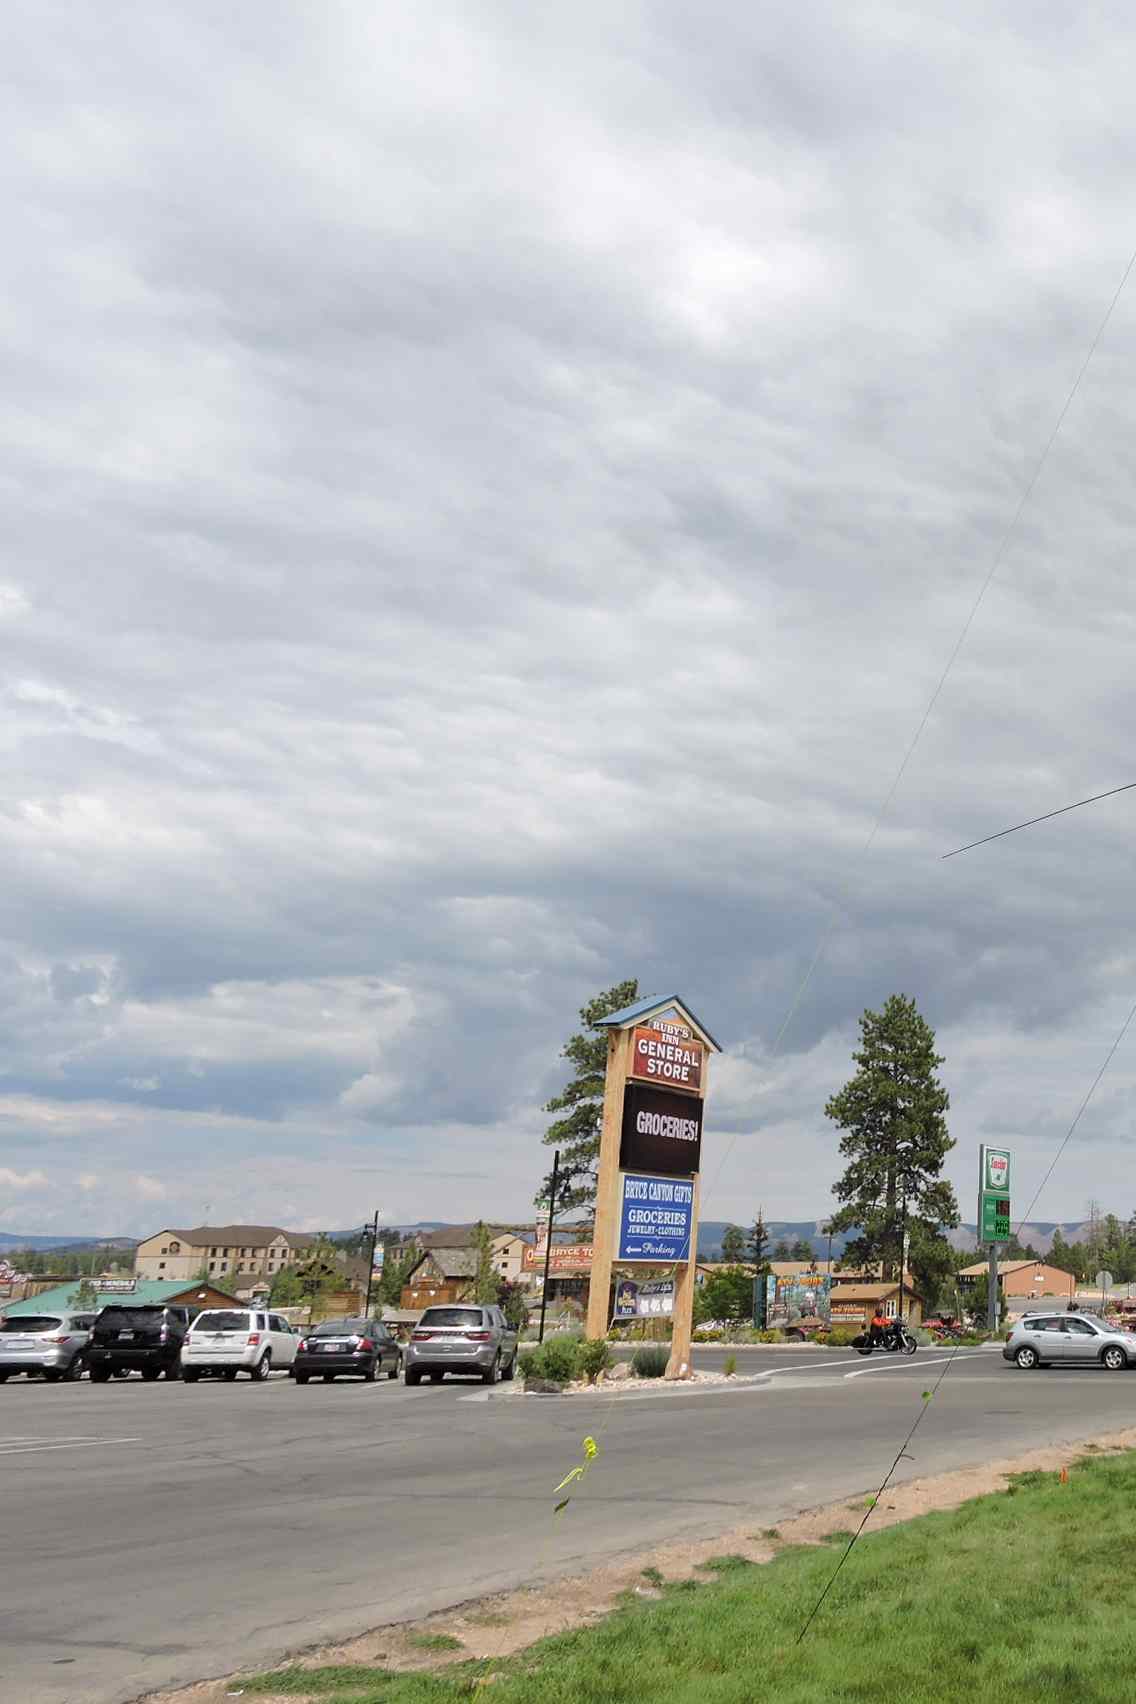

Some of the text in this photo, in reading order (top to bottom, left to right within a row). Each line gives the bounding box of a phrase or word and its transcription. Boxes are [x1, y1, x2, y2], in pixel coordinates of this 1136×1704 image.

[653, 1020, 689, 1039] RUBY'S
[661, 1033, 680, 1046] INN
[638, 1039, 699, 1068] GENERAL
[647, 1058, 689, 1081] STORE
[636, 1110, 699, 1142] GROCERIES!
[625, 1180, 692, 1204] BRYCE CANYON GIFTS
[628, 1209, 687, 1226] GROCERIES
[642, 1241, 675, 1257] Parking
